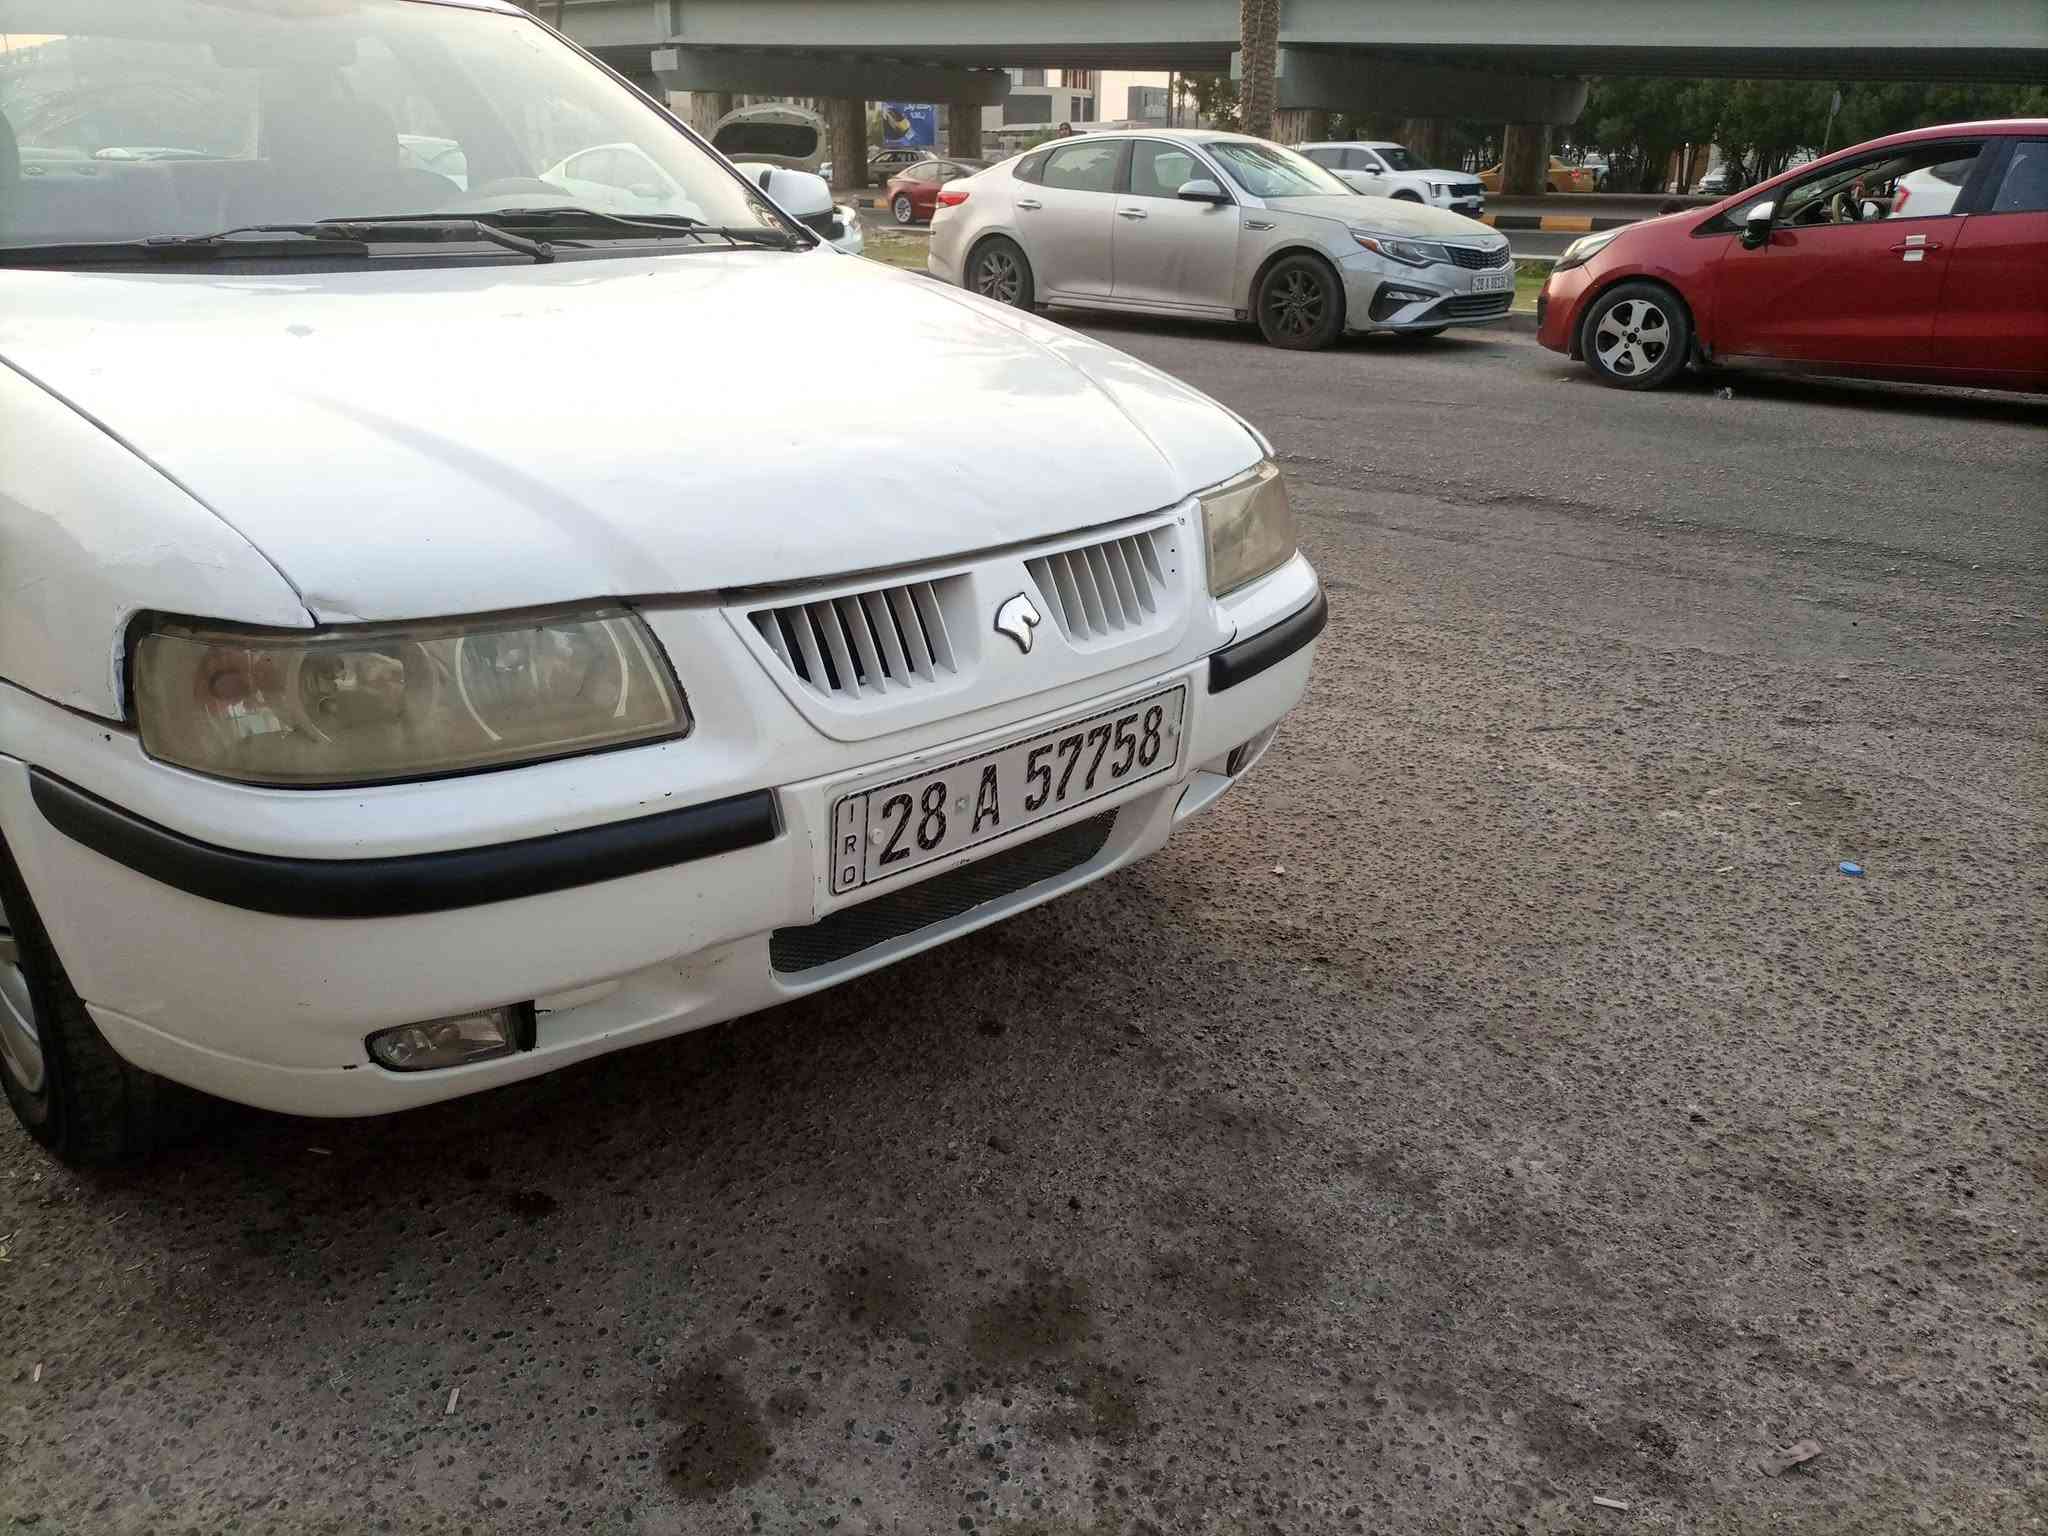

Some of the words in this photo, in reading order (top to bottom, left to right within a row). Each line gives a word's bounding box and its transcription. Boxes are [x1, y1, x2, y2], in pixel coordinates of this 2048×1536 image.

[880, 782, 946, 865] 28
[972, 764, 999, 833] A
[1025, 705, 1162, 811] 57758
